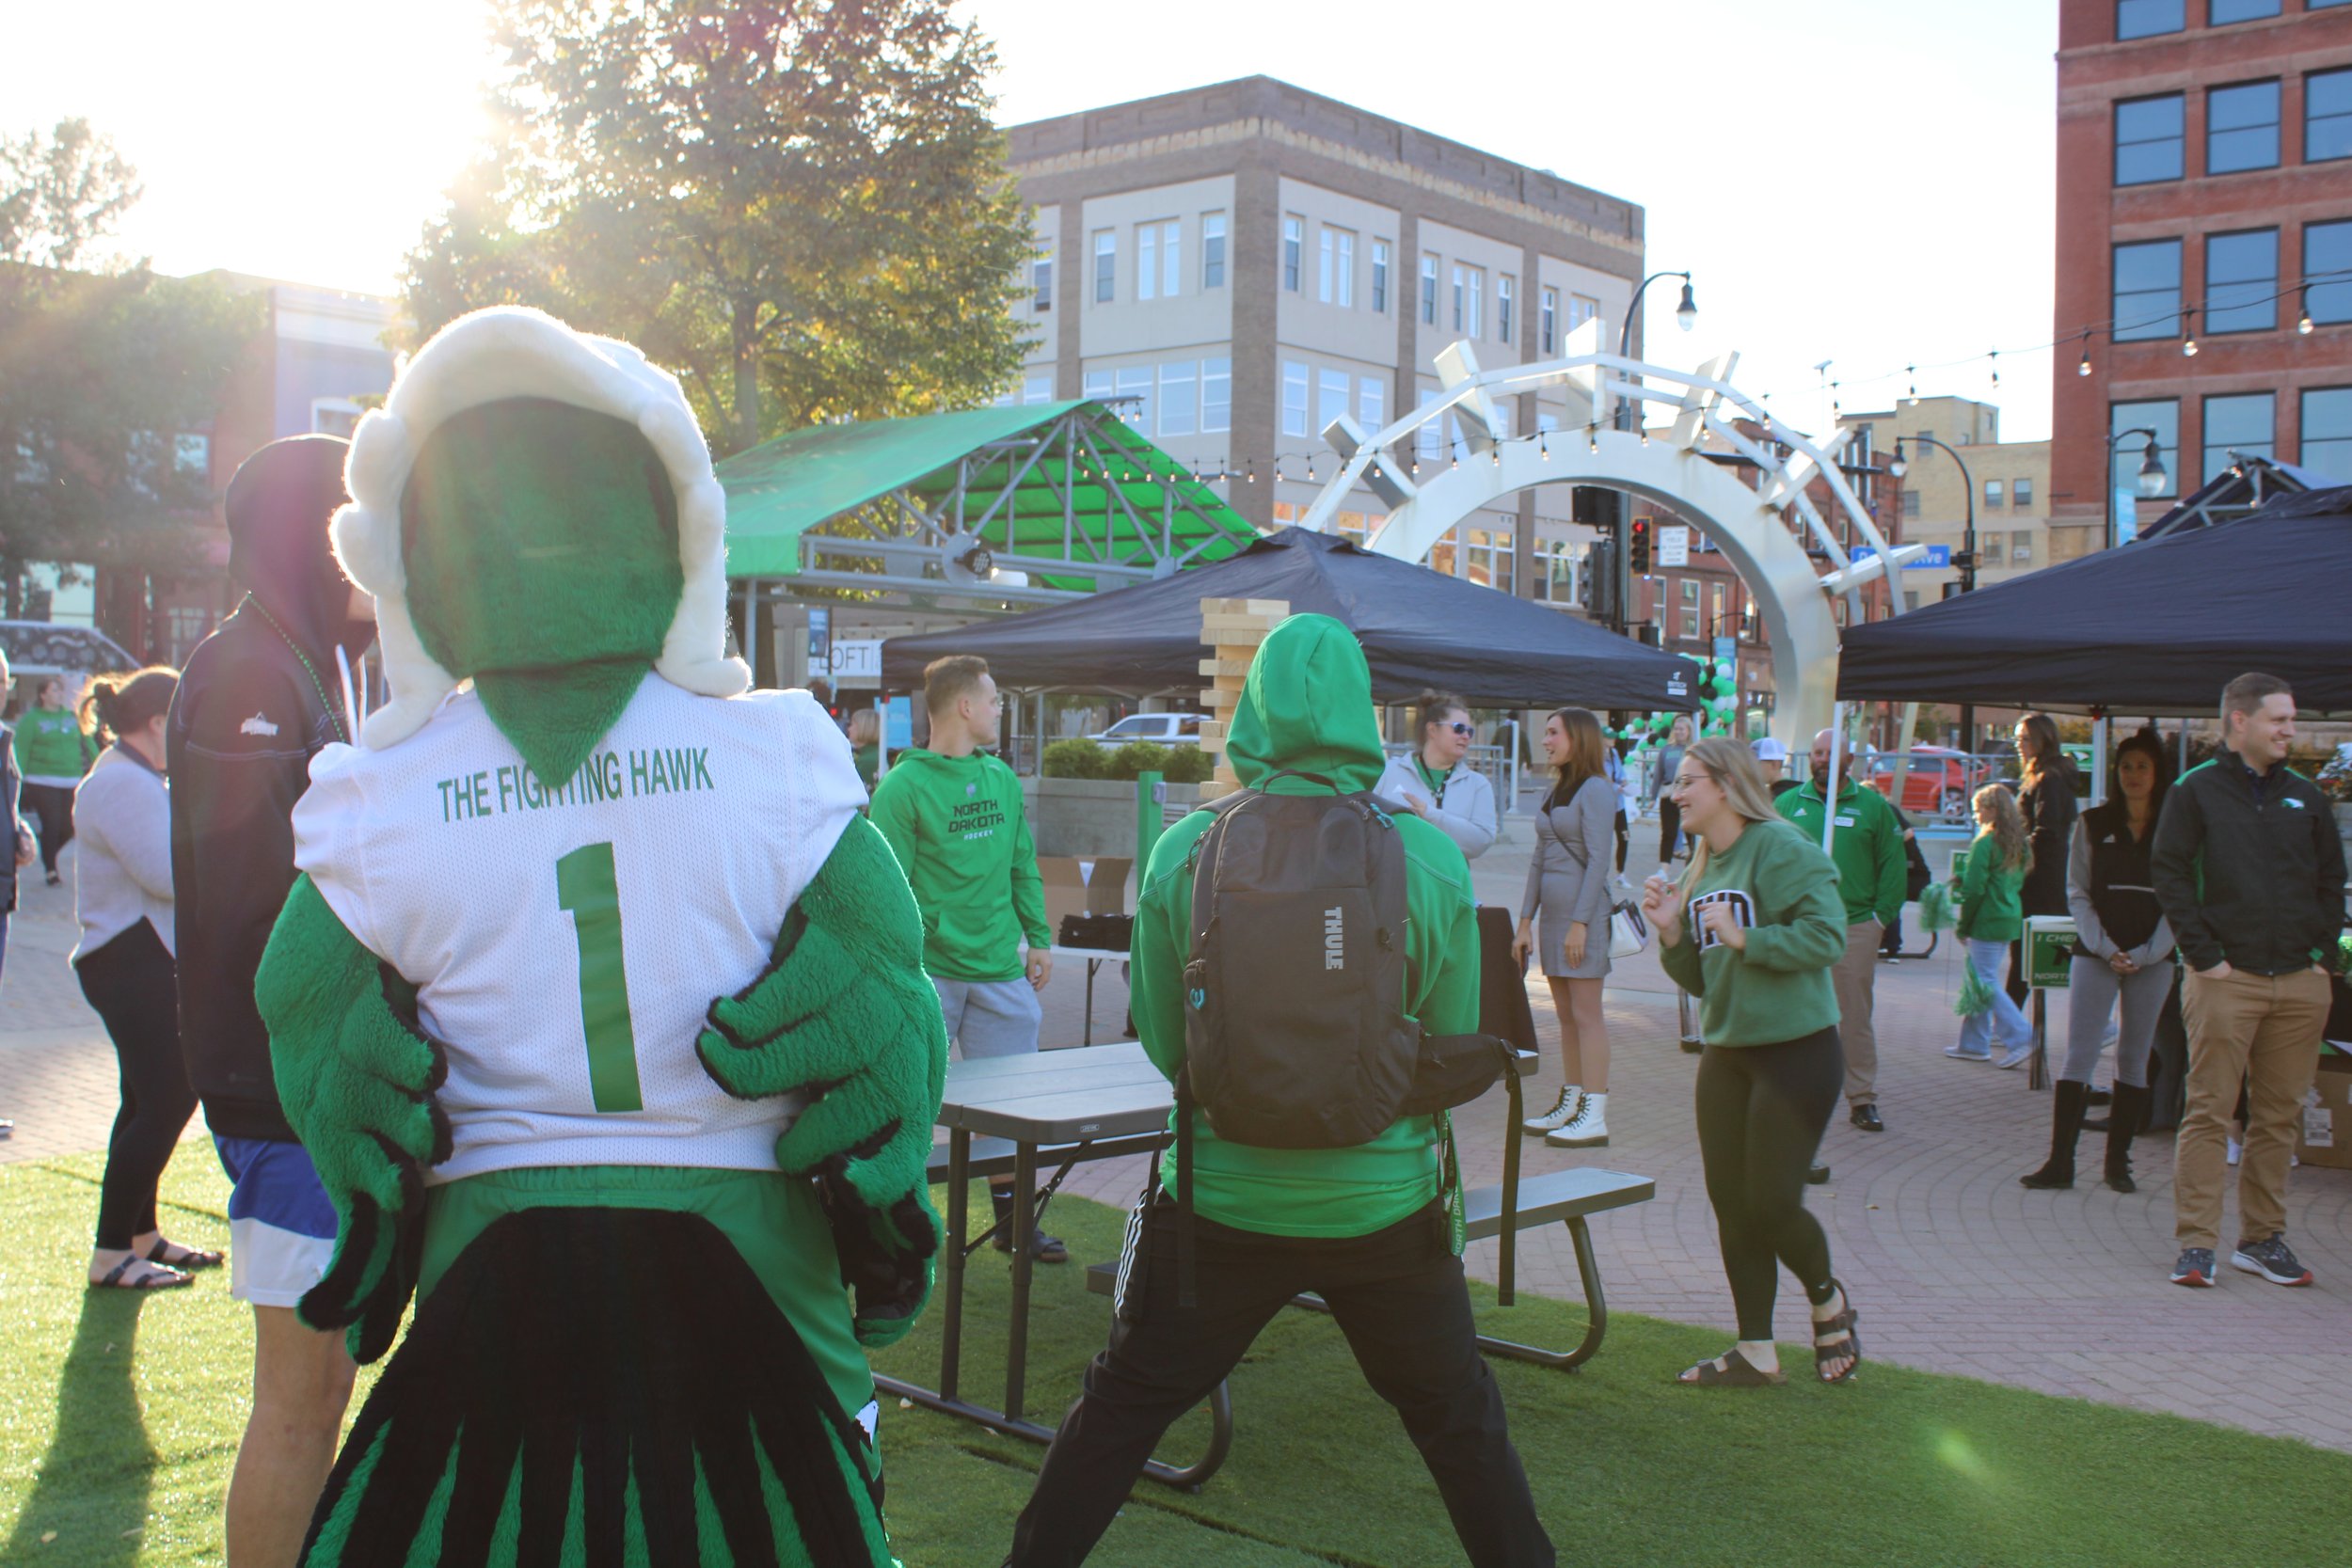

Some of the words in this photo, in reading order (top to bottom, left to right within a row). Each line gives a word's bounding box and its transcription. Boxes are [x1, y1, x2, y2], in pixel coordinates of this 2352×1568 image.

[437, 771, 491, 823] THE
[628, 748, 715, 797] HAWK
[948, 813, 1006, 833] DAKOTA
[953, 799, 999, 817] NORTH
[963, 829, 993, 841] HOCKEY
[1324, 906, 1344, 971] THULE
[556, 842, 644, 1113] 1
